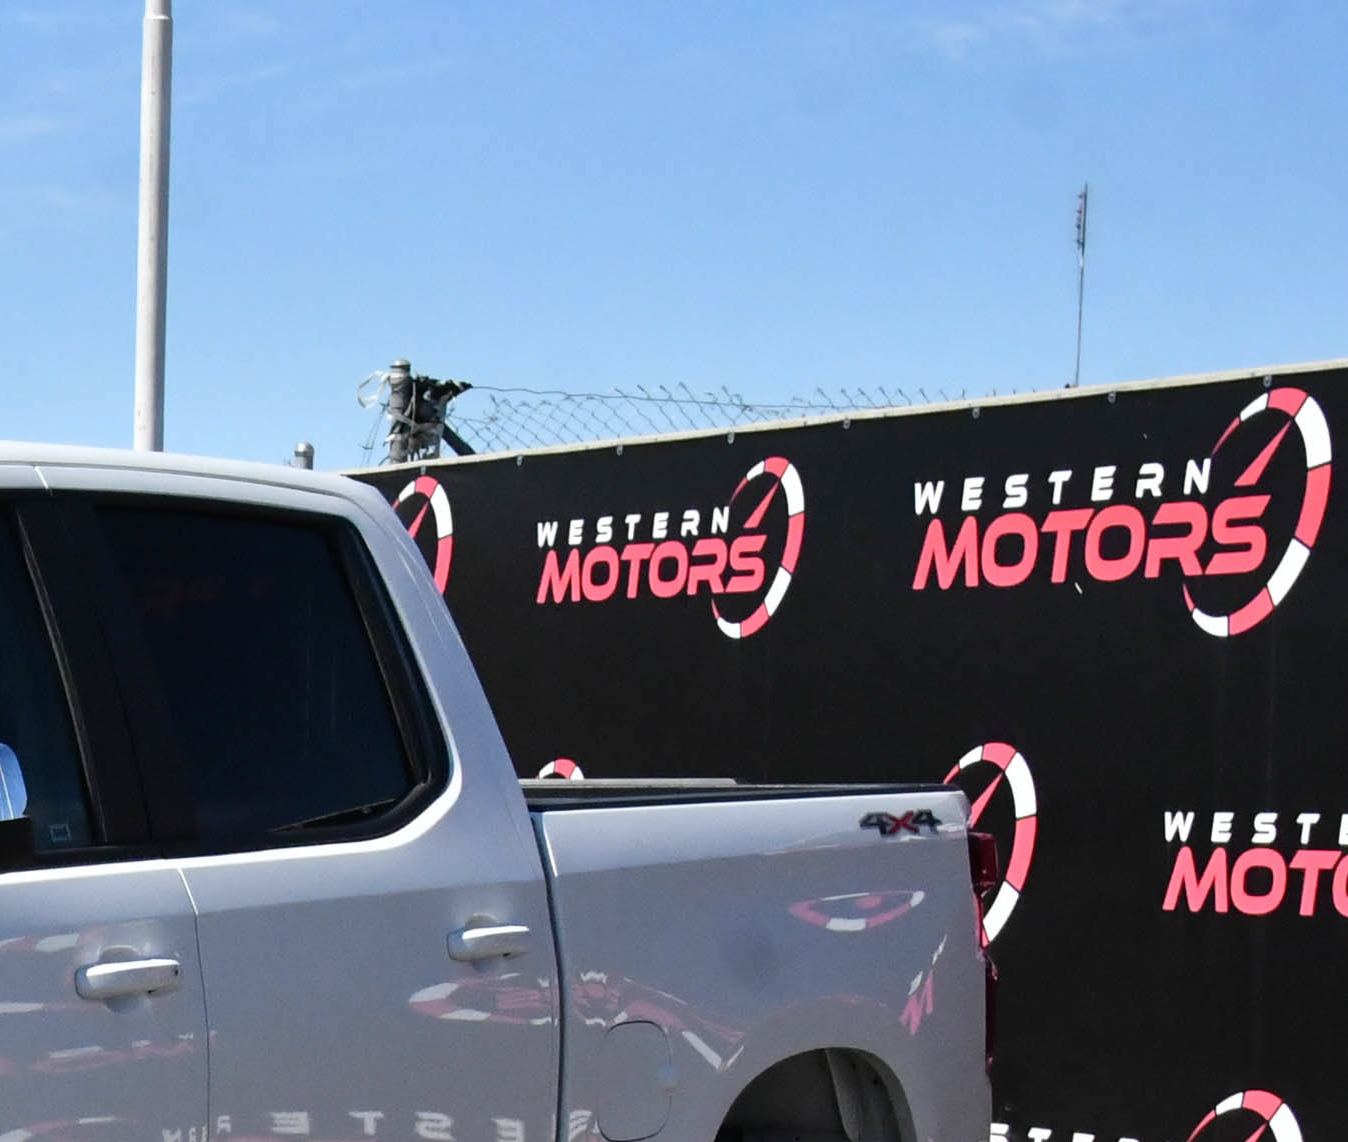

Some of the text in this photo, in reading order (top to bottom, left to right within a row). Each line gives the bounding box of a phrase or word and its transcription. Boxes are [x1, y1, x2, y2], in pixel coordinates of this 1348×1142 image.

[914, 457, 1212, 516] WESTERN
[537, 505, 730, 549] WESTERN
[912, 494, 1272, 591] MOTORS
[536, 534, 768, 604] MOTORS
[1161, 845, 1348, 918] MOT
